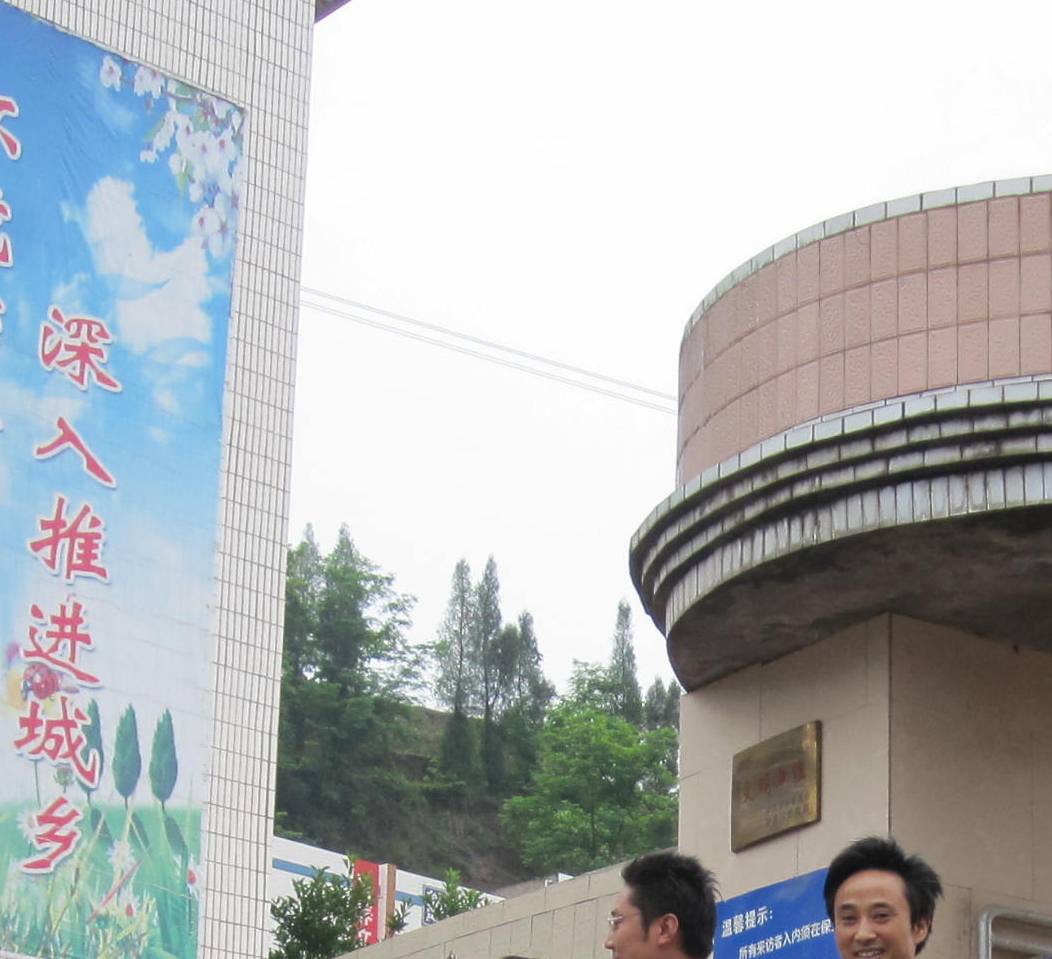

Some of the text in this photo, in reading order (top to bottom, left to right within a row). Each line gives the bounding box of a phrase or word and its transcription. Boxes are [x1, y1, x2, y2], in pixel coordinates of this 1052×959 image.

[13, 306, 119, 872] 深入推进城乡
